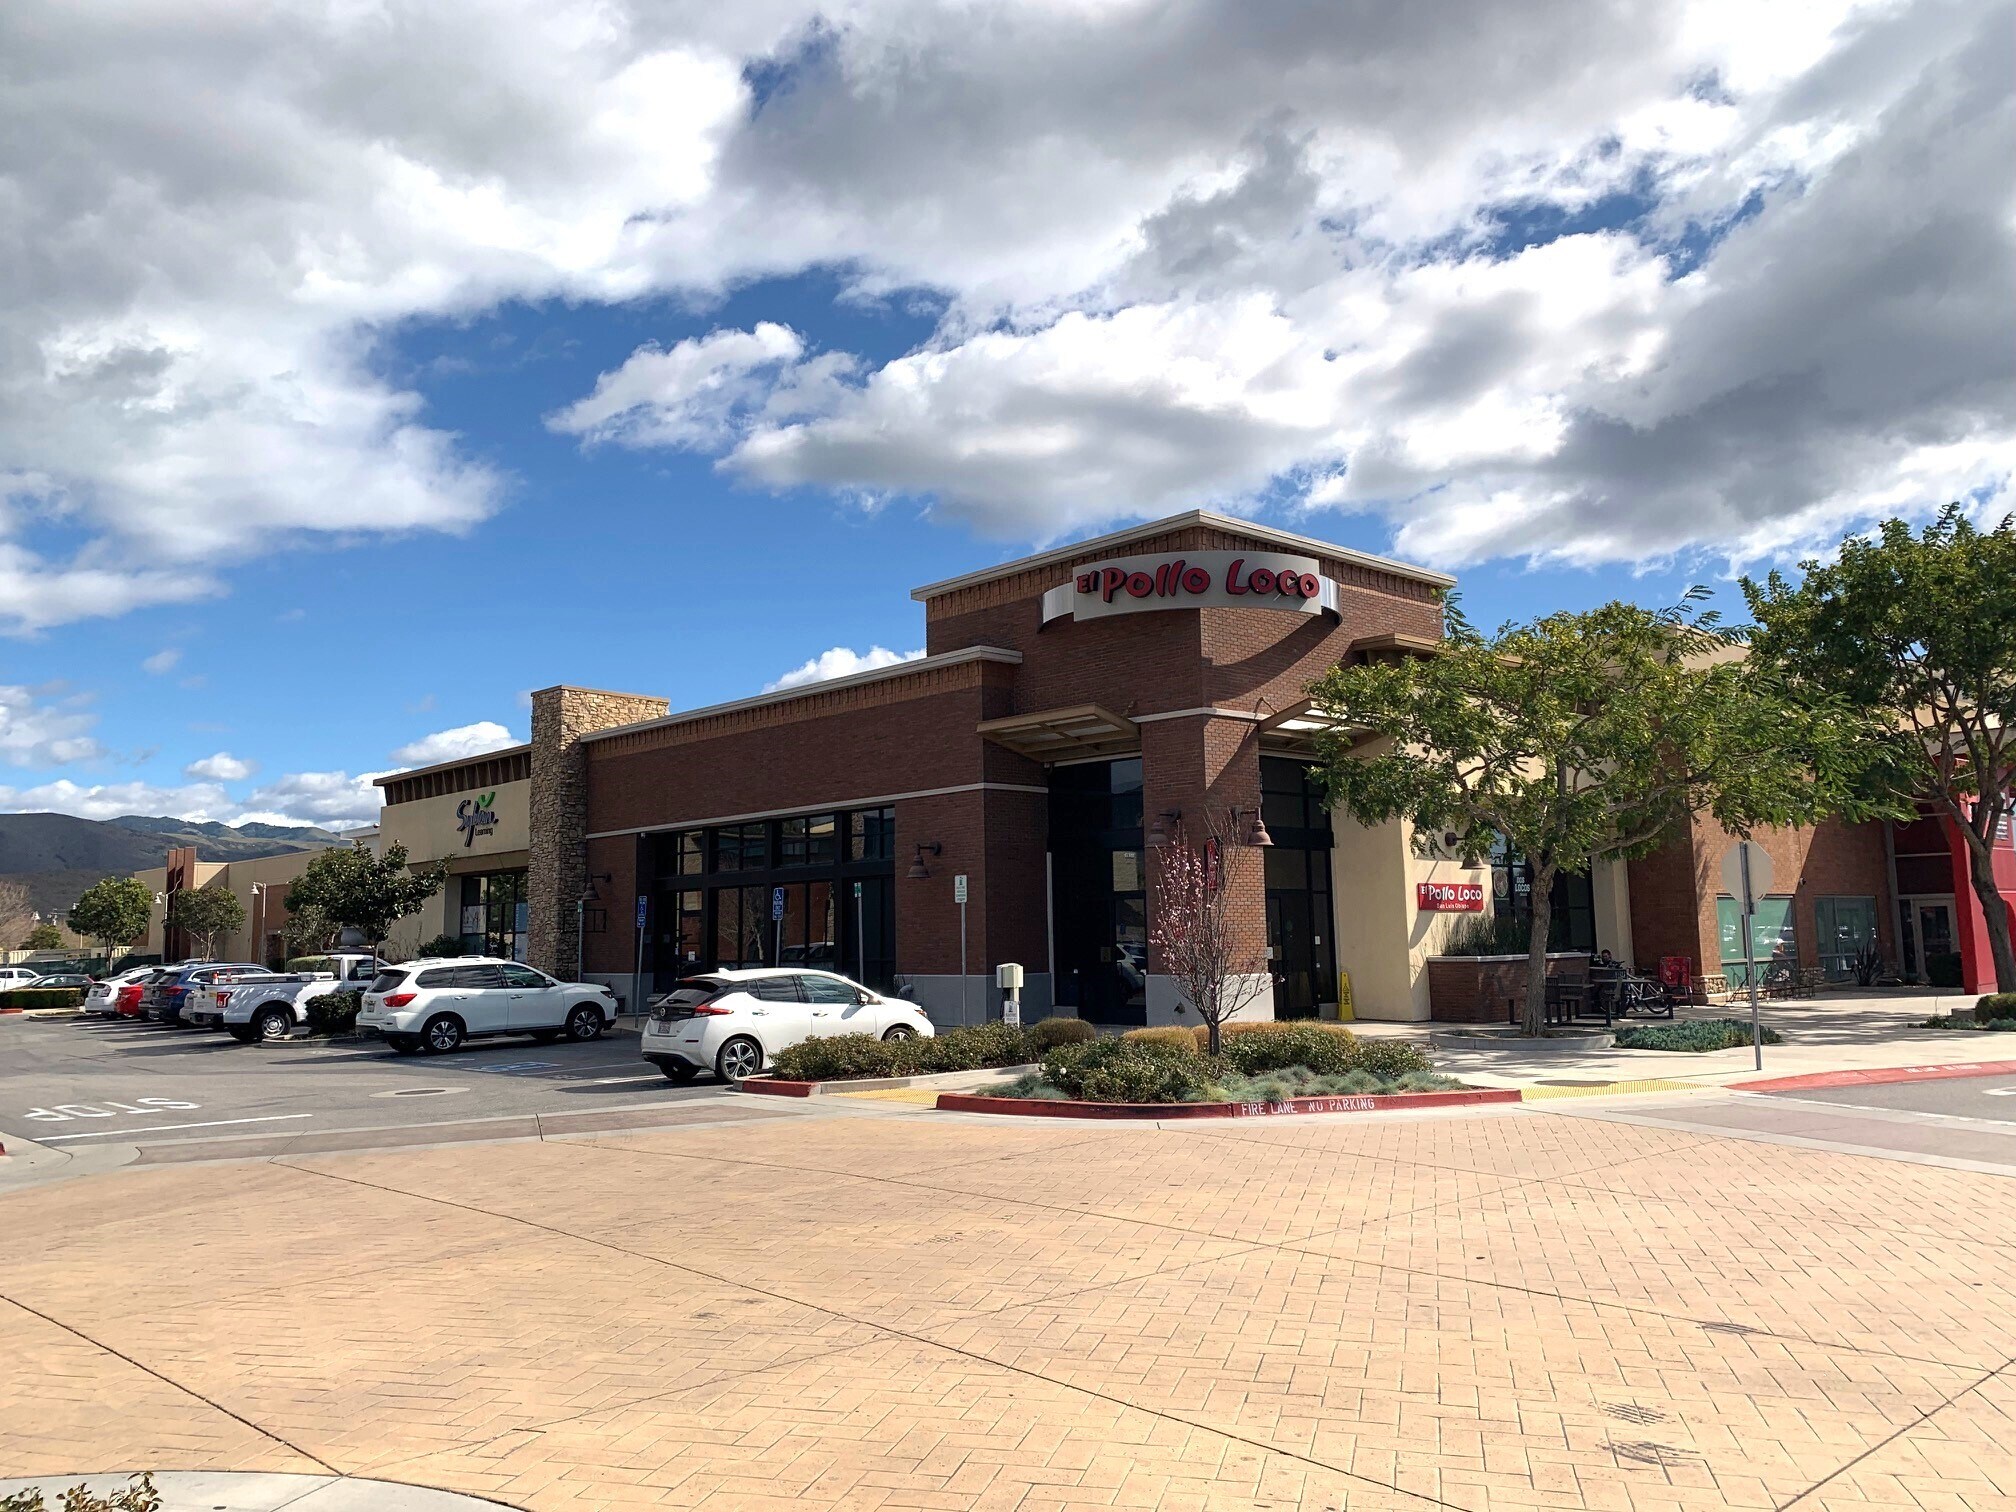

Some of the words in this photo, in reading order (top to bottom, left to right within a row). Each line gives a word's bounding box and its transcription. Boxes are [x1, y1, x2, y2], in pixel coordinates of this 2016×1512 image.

[1077, 570, 1100, 594] El
[1101, 559, 1211, 603] Pollo
[1226, 558, 1320, 599] Loco
[1428, 885, 1455, 901] Pollo
[1457, 885, 1482, 901] Loco
[1514, 883, 1531, 892] LOCOS
[1241, 1103, 1266, 1116] FIRE
[1270, 1102, 1298, 1115] LANE
[1308, 1101, 1324, 1112] NO
[1329, 1098, 1375, 1111] PARKING
